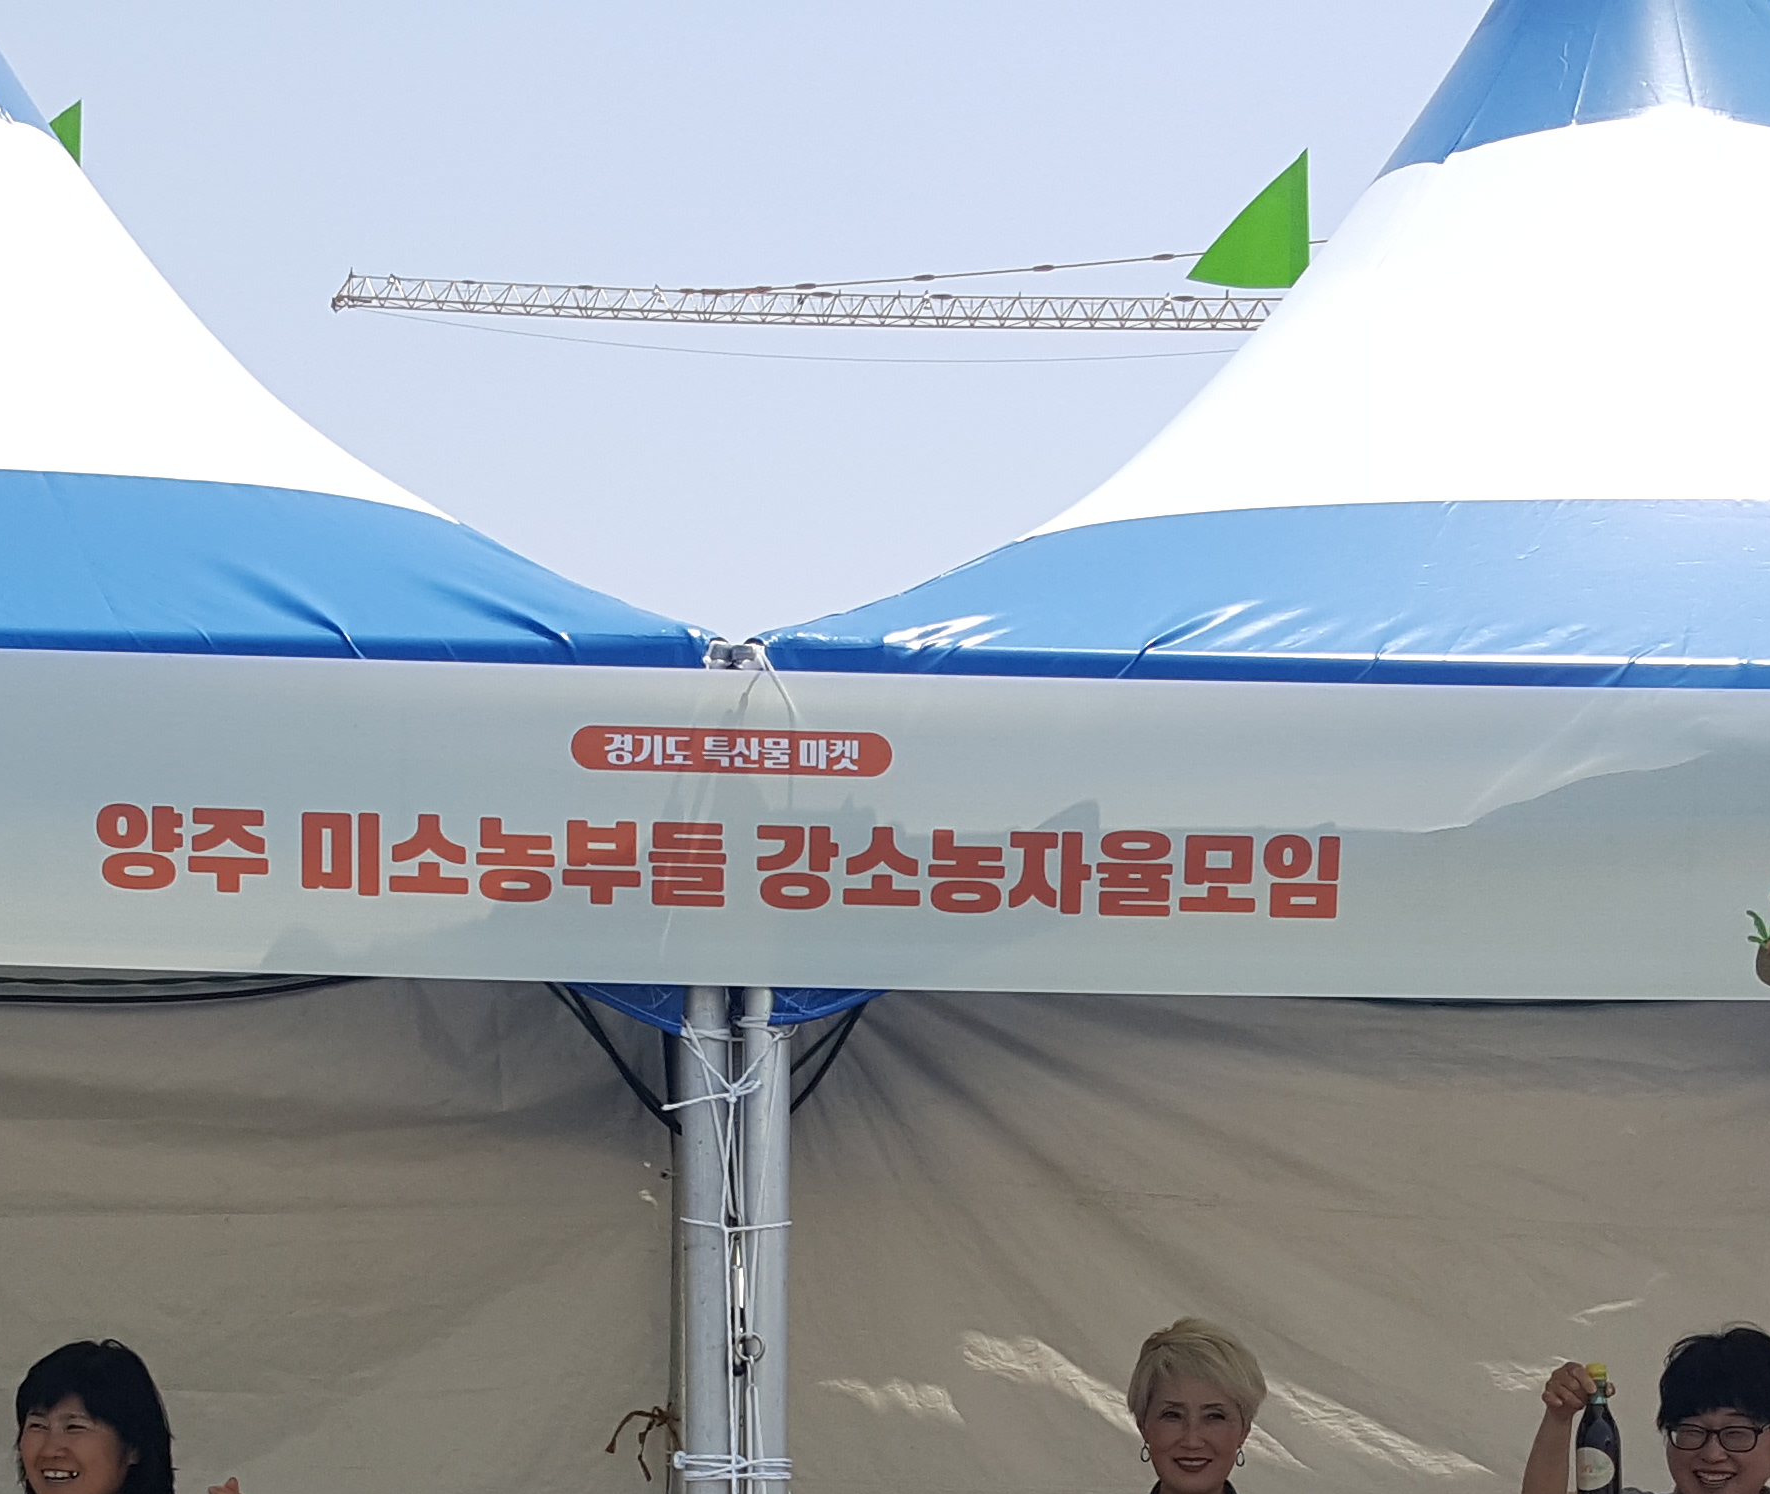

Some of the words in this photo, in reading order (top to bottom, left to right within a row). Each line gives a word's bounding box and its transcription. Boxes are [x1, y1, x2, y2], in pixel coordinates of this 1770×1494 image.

[604, 733, 693, 766] 경기도
[702, 735, 790, 770] 특산물
[798, 738, 862, 772] 마켓
[96, 802, 269, 894] 양주
[301, 810, 727, 907] 미소농부들
[756, 825, 1341, 919] 강소농자율모임
